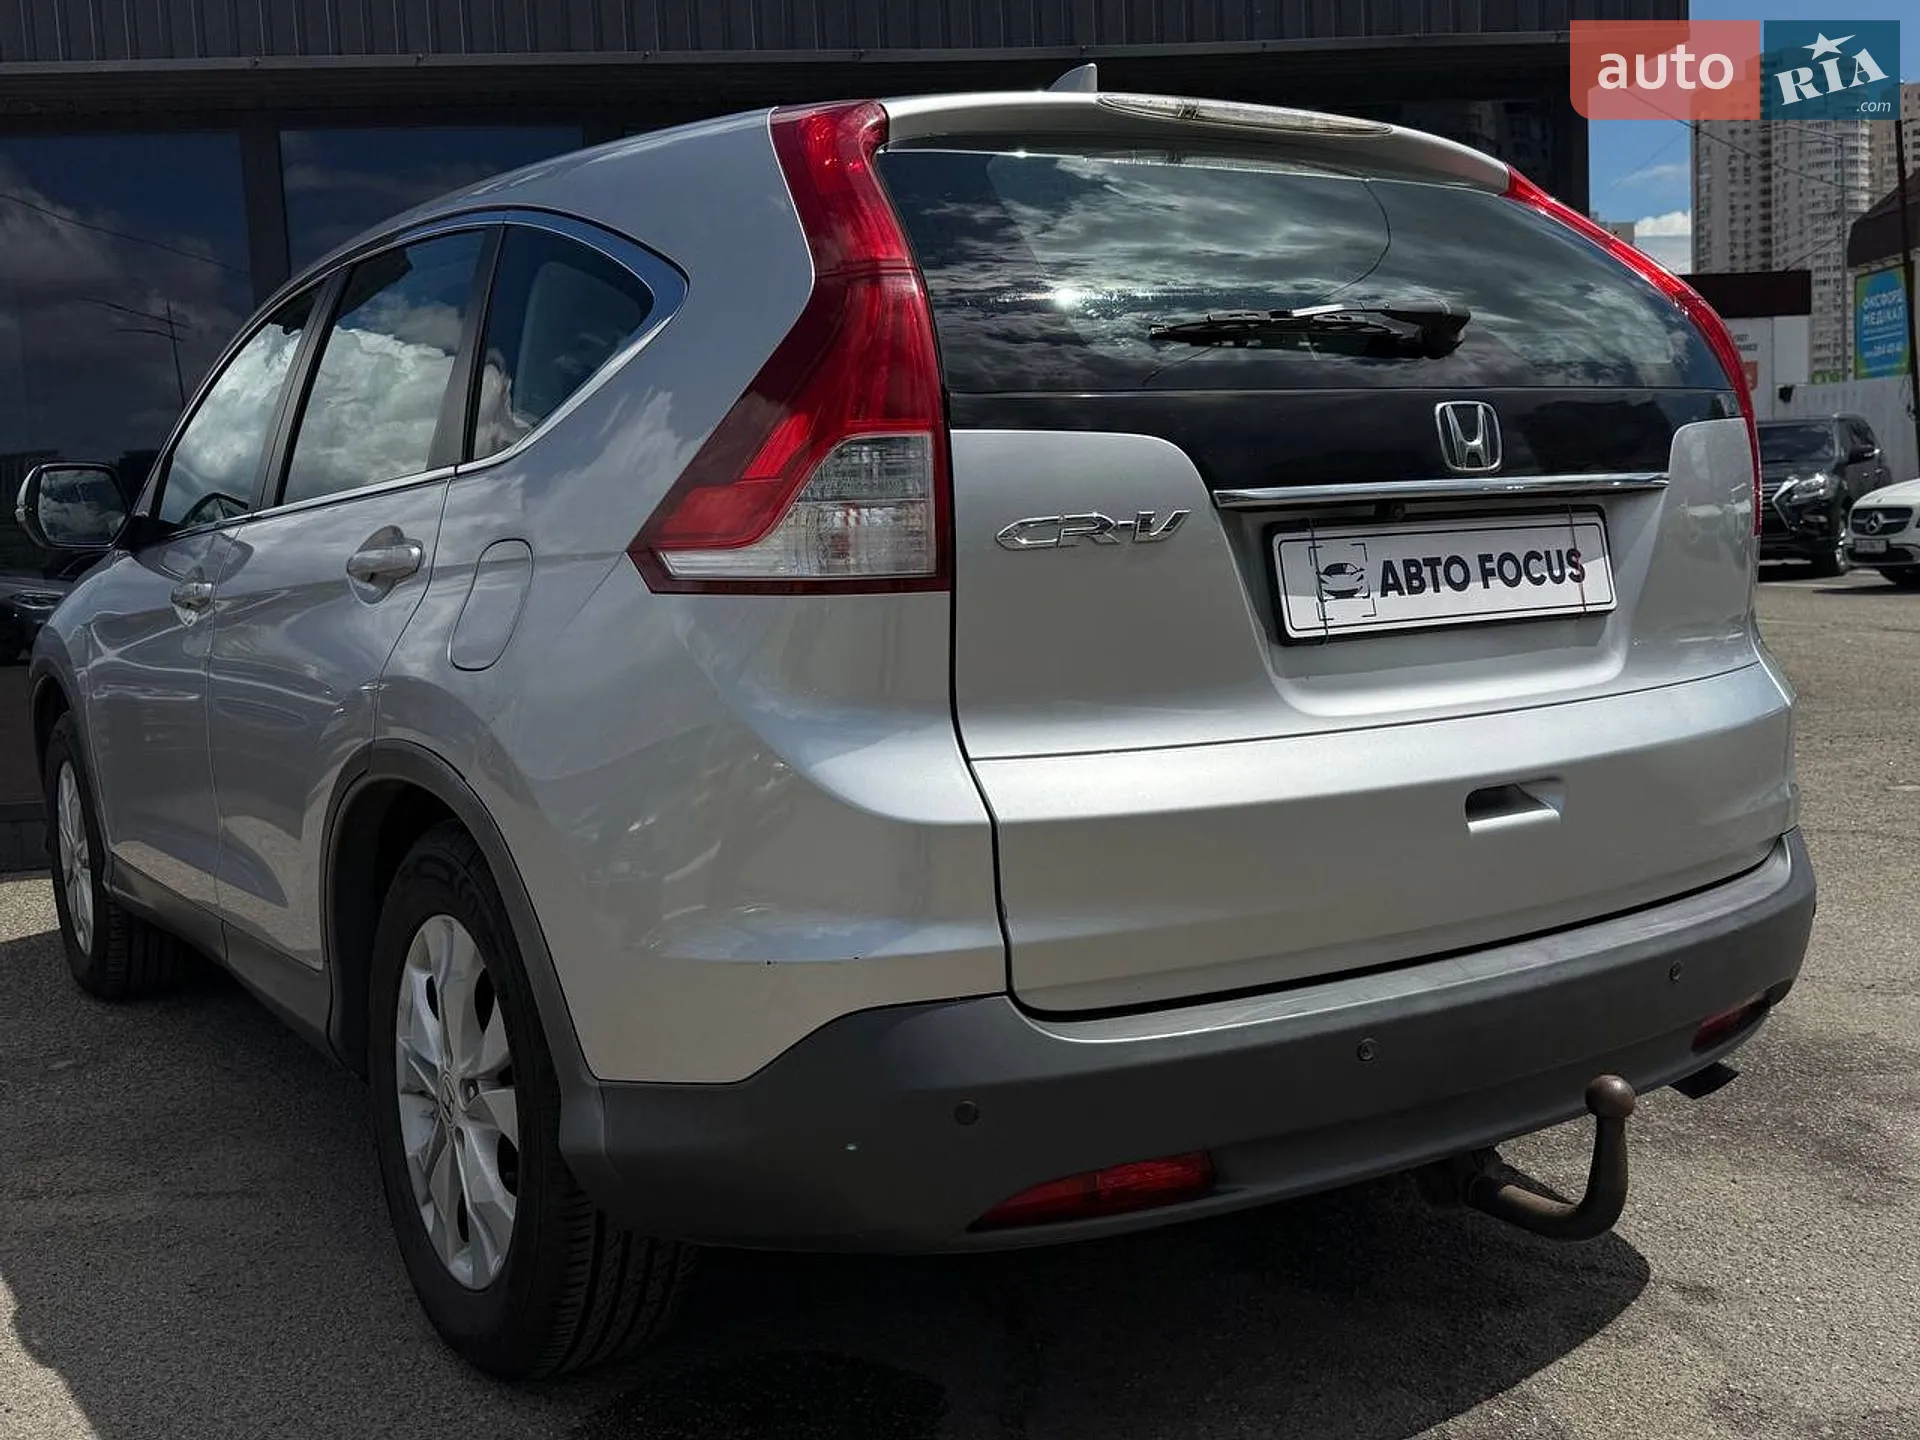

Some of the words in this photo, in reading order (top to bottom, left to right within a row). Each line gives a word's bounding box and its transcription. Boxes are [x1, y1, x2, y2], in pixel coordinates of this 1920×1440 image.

[995, 509, 1191, 551] CR-V
[1379, 554, 1471, 598] АВТО
[1477, 548, 1586, 590] FOCUS
